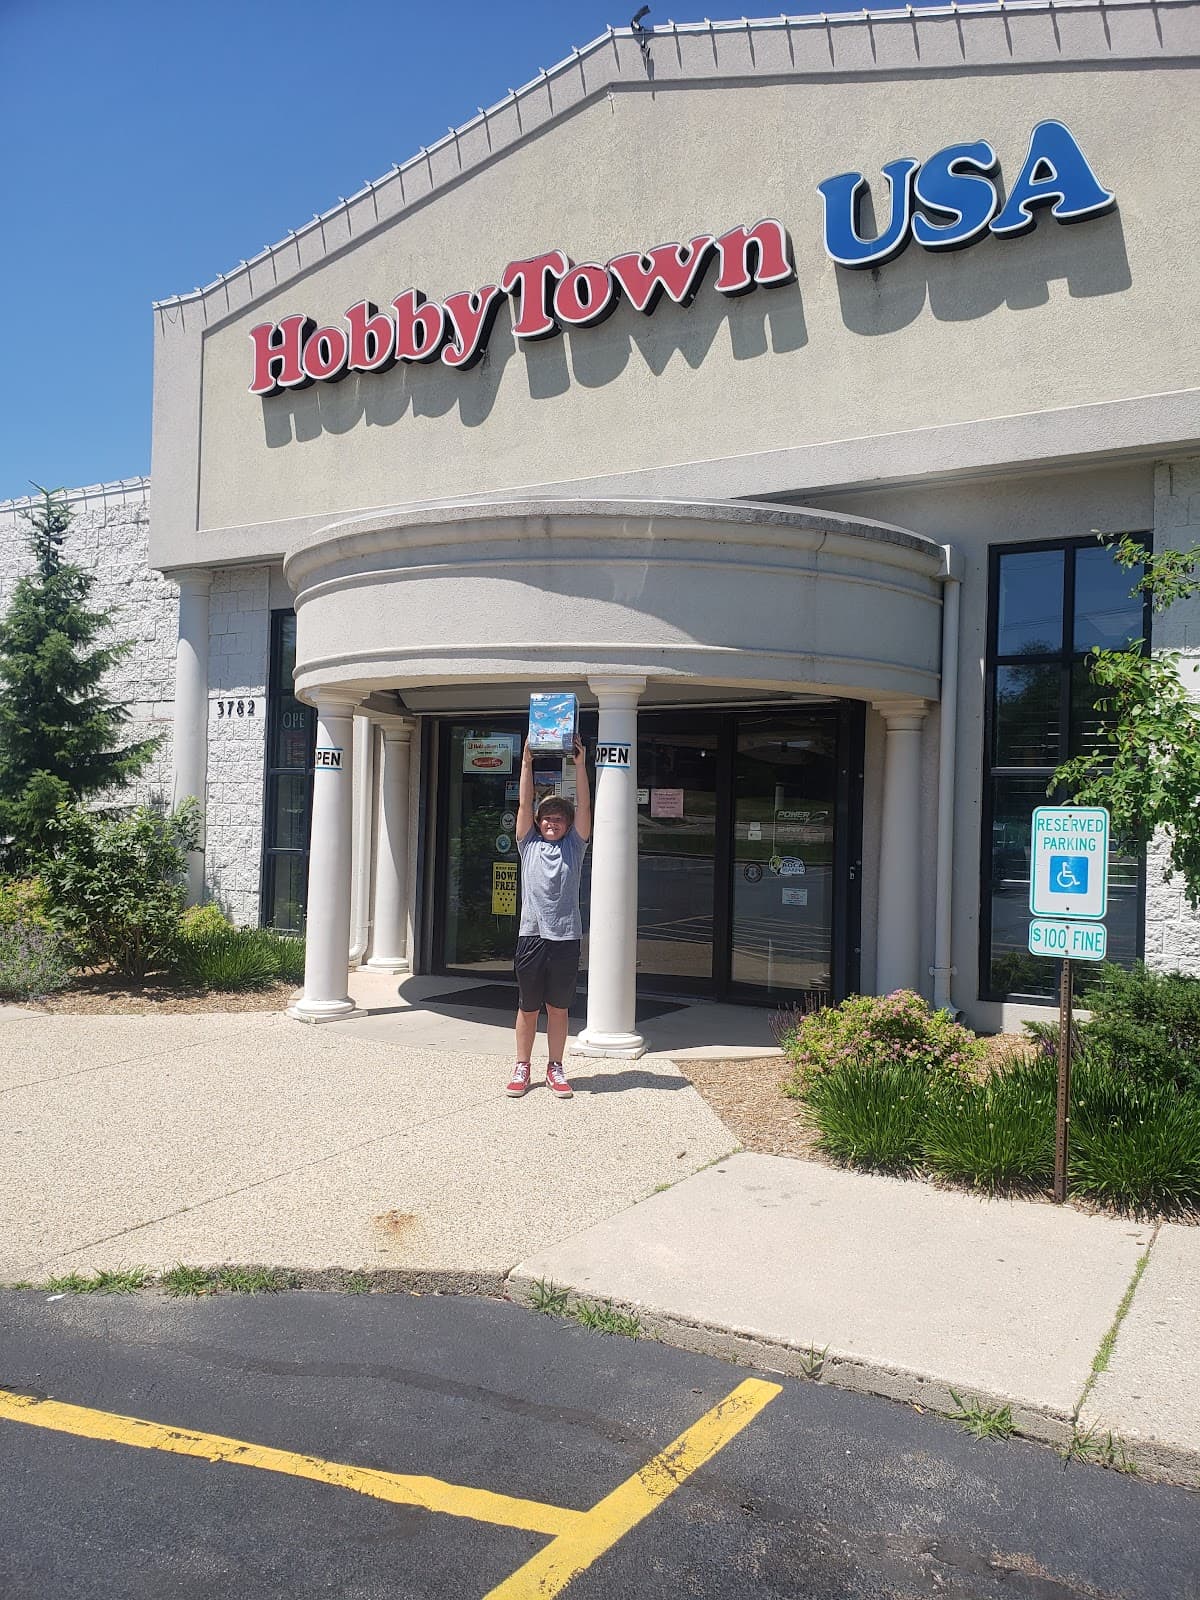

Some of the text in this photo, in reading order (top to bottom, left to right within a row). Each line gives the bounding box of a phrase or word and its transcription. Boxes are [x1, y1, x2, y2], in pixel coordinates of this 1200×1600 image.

[248, 118, 1116, 398] HobbyTown USA
[217, 699, 255, 719] 3782
[282, 711, 305, 729] OPE
[315, 751, 341, 766] PEN
[1037, 818, 1104, 833] RESERVED
[1043, 837, 1097, 852] PARKING
[495, 880, 516, 891] FREE
[1033, 927, 1103, 953] $100 FINE
